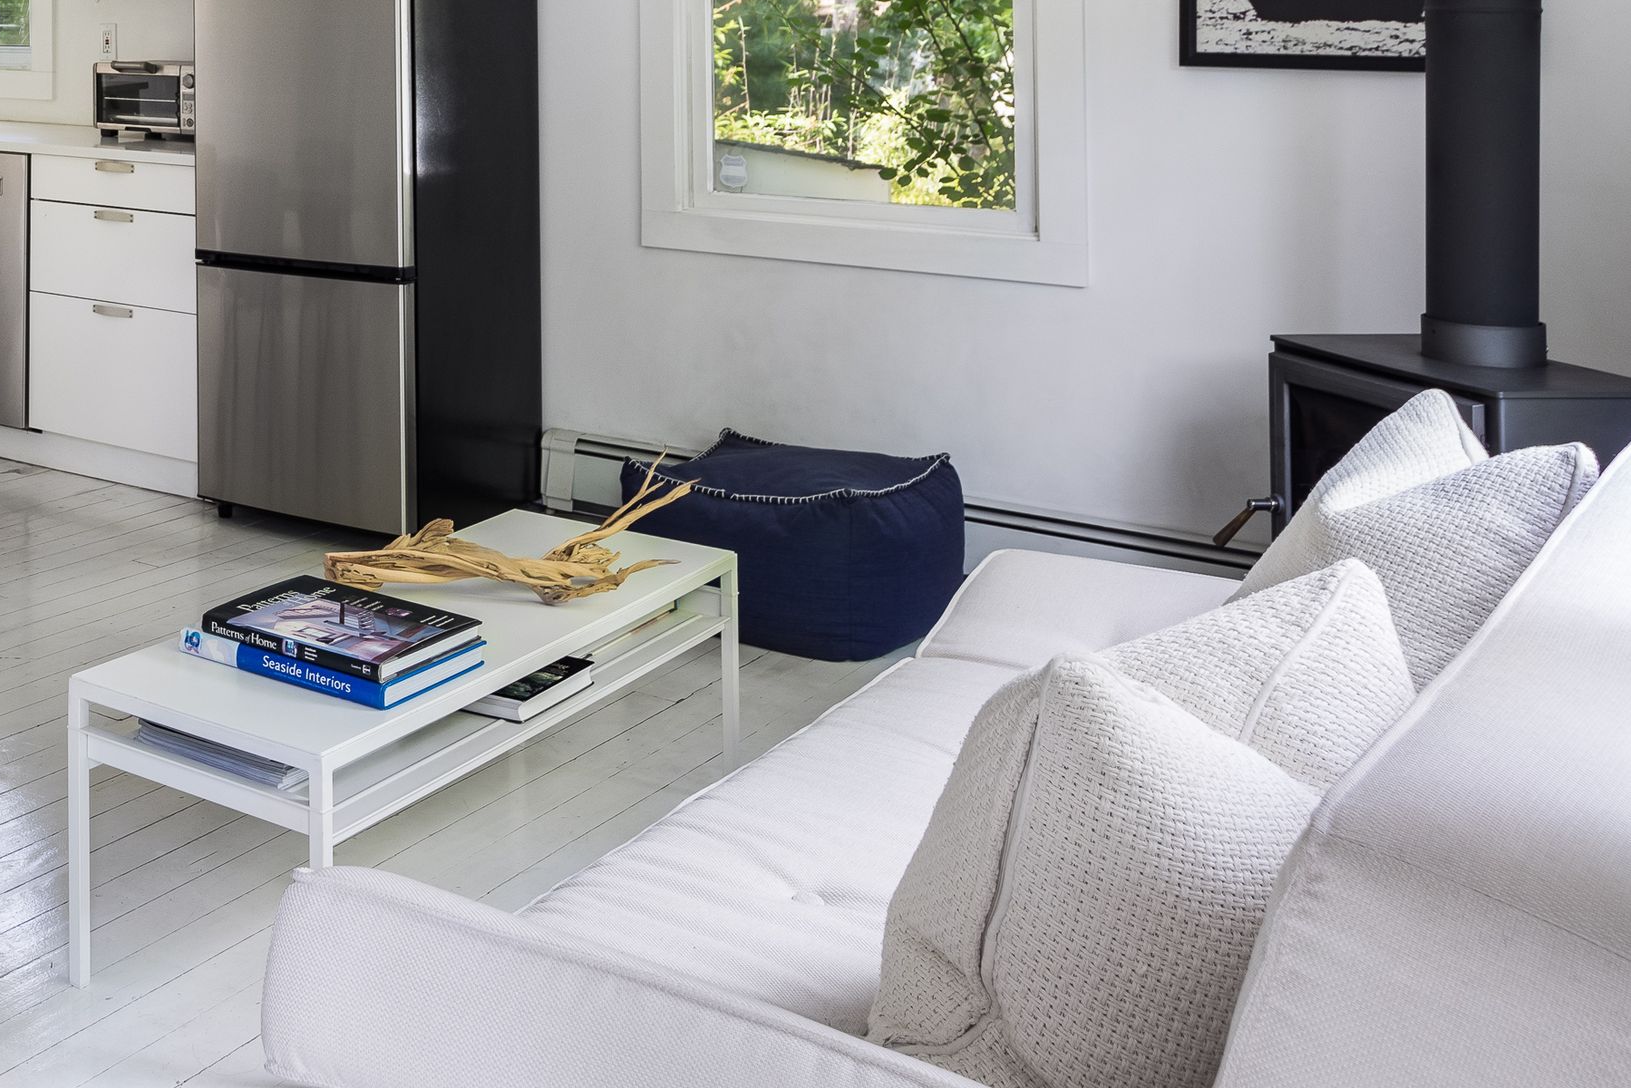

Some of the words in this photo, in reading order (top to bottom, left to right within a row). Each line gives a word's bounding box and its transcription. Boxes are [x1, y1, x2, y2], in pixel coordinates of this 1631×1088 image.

[211, 621, 245, 641] Patterns
[251, 632, 277, 650] Home
[262, 655, 303, 678] Seaside
[305, 668, 351, 693] Interiors
